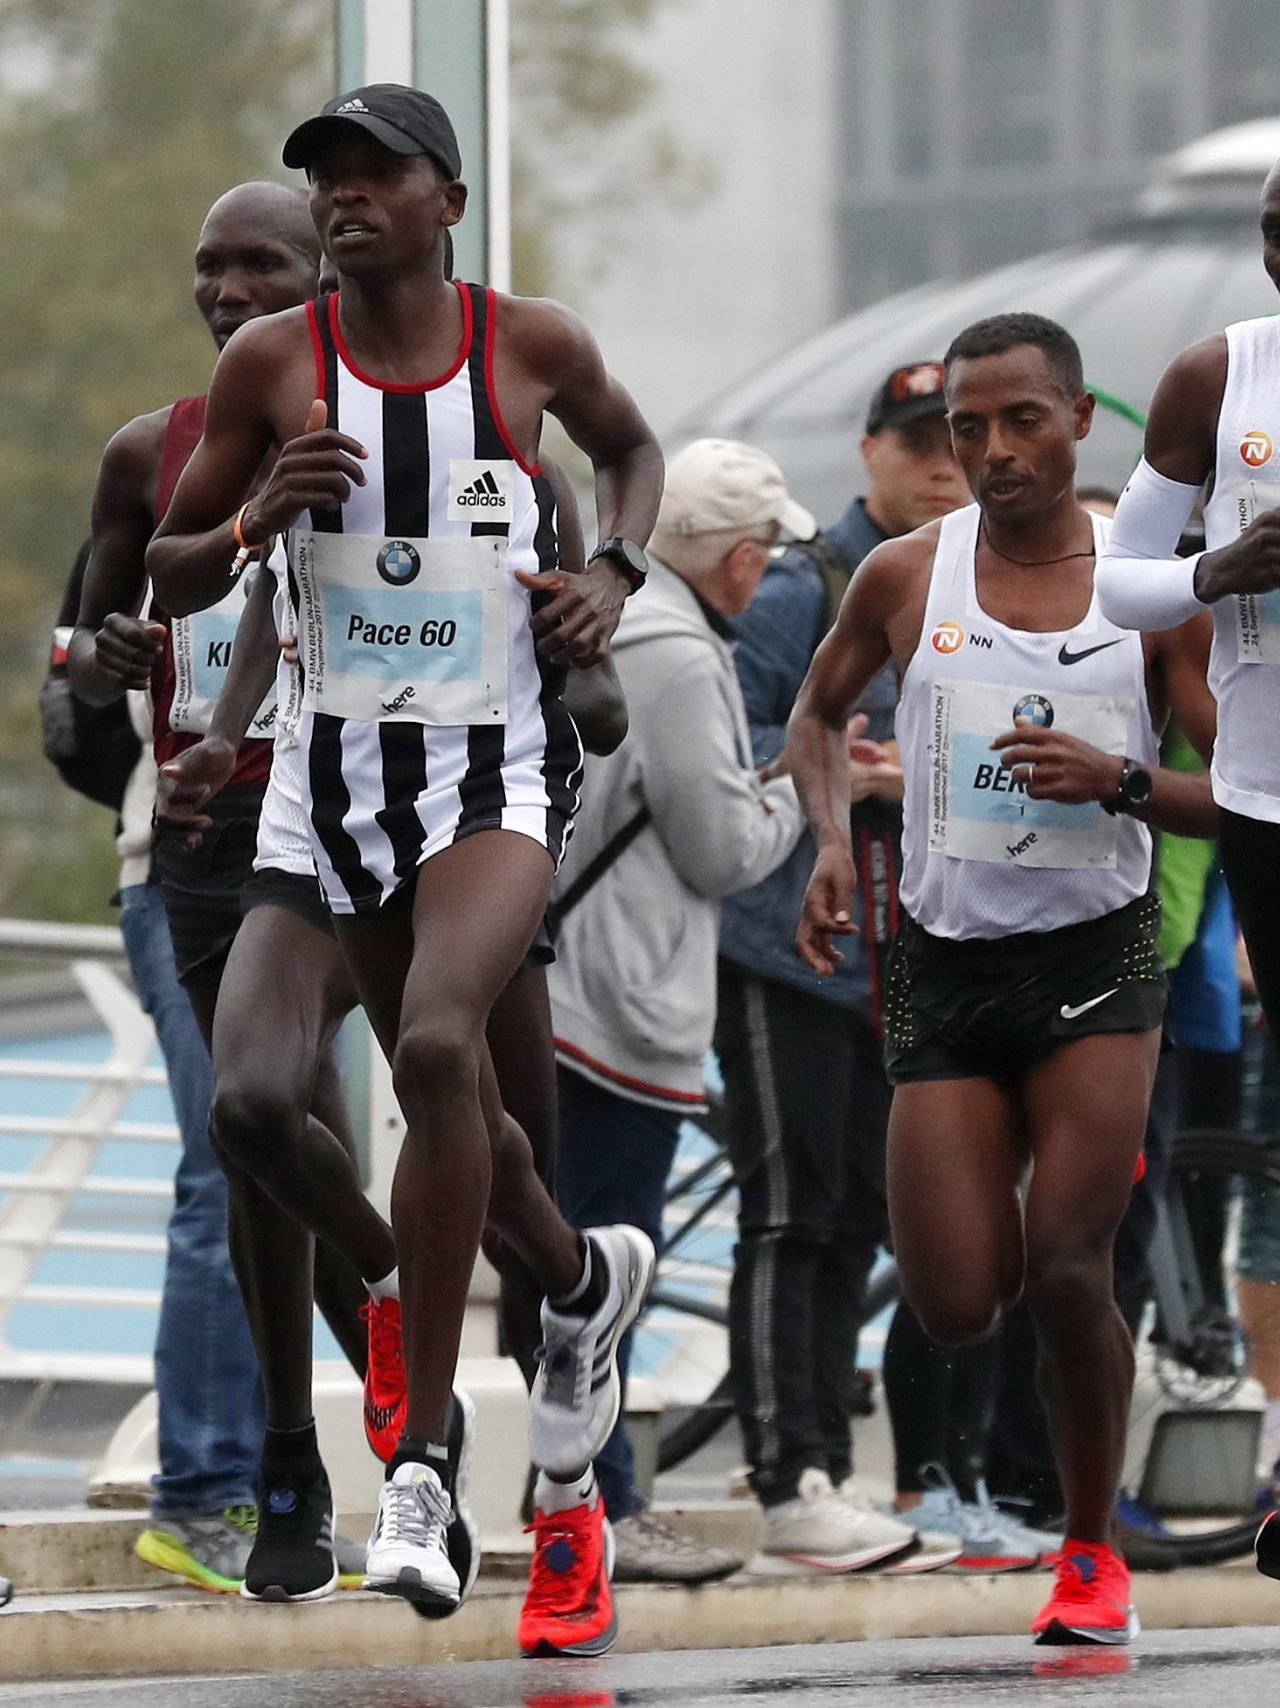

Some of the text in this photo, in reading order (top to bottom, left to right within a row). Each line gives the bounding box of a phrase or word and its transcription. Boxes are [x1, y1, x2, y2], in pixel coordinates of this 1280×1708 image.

[456, 493, 507, 507] adidas
[380, 540, 418, 557] BMW
[299, 546, 316, 646] BERLIN-MARATHON
[314, 604, 322, 626] 2017
[347, 614, 457, 647] Pace 60
[969, 633, 993, 649] NN
[308, 647, 317, 674] BMW
[316, 626, 325, 677] September
[382, 686, 416, 713] here
[940, 752, 948, 774] 2017
[1007, 832, 1038, 857] here
